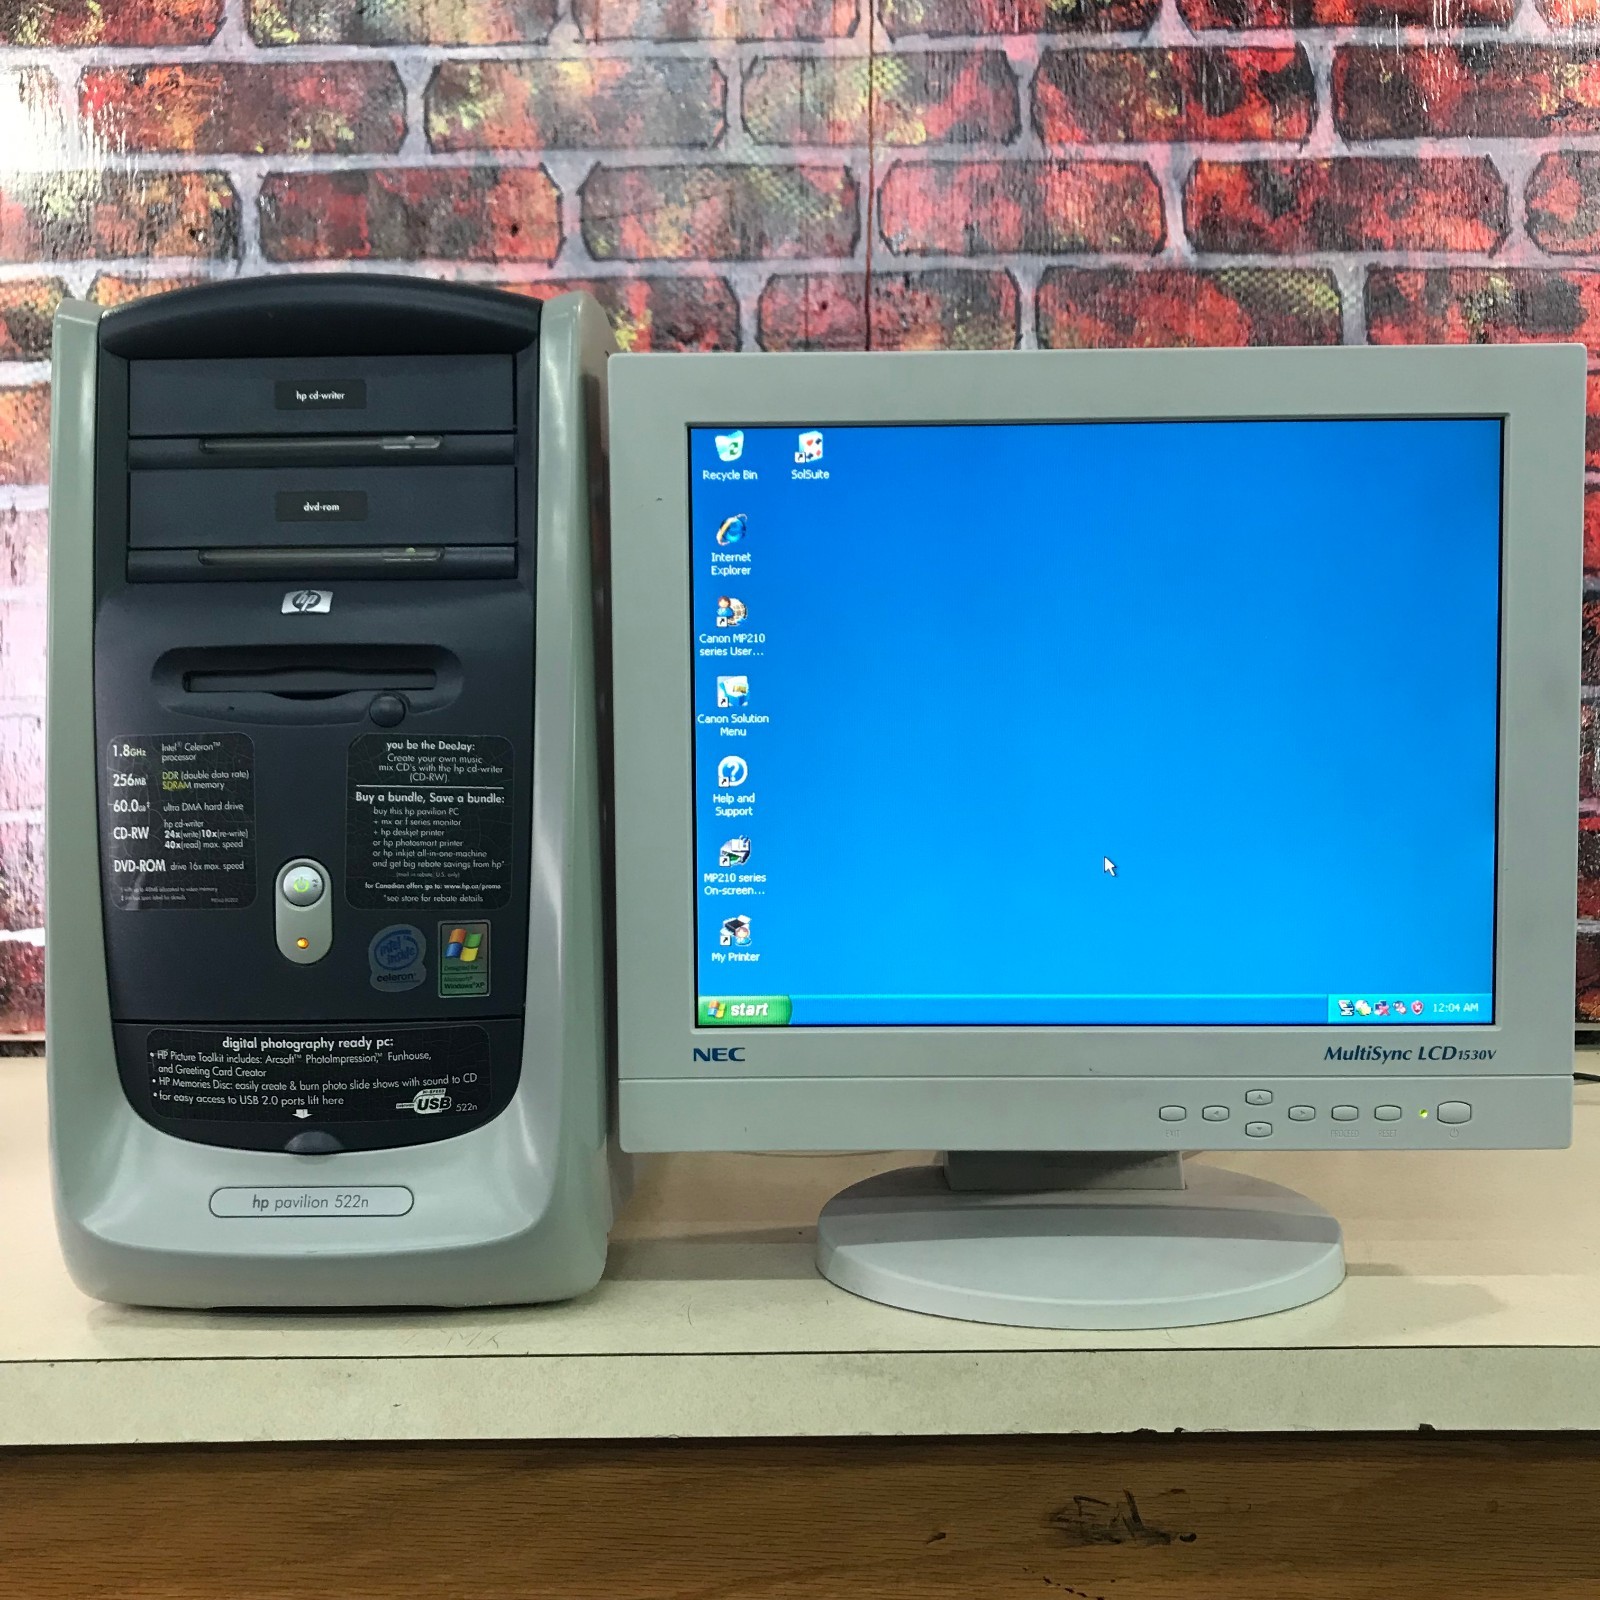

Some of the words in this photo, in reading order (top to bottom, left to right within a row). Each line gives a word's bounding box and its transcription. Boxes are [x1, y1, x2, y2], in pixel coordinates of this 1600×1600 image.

[296, 390, 307, 402] hp
[309, 390, 345, 400] cd-writer
[703, 470, 740, 481] Recycle
[743, 470, 758, 480] Bin
[791, 469, 830, 479] SolSuite
[303, 502, 340, 511] dvd-rom
[711, 552, 751, 562] Internet
[711, 565, 751, 576] Explorer
[296, 590, 318, 611] hp
[699, 634, 730, 644] Canon
[733, 633, 766, 643] MP210
[700, 647, 728, 656] series
[730, 646, 764, 656] User...
[697, 714, 729, 724] Canon
[731, 714, 770, 723] Solution
[720, 728, 746, 736] Menu
[113, 744, 147, 757] 1.8GHz
[387, 742, 404, 752] you
[406, 740, 419, 750] be
[421, 740, 436, 750] the
[438, 741, 475, 752] DeeJay:
[161, 753, 197, 763] processor
[387, 753, 415, 762] Create
[417, 755, 436, 764] your
[459, 756, 483, 764] music
[378, 763, 393, 771] mix
[396, 763, 417, 772] CD's
[418, 763, 436, 772] with
[439, 763, 452, 772] the
[453, 763, 465, 774] hp
[467, 764, 504, 773] cd-writer
[162, 771, 179, 780] DDR
[181, 770, 209, 781] (double
[211, 771, 229, 779] data
[231, 770, 249, 779] rate)
[162, 781, 192, 790] SDRAM
[193, 782, 225, 790] memory
[355, 791, 375, 804] Buy
[377, 794, 385, 802] a
[388, 791, 426, 804] bundle,
[429, 792, 455, 803] Save
[457, 795, 464, 803] a
[467, 793, 505, 804] bundle:
[713, 793, 734, 805] Help
[736, 792, 756, 803] and
[163, 803, 180, 812] ultra
[181, 803, 202, 811] DMA
[204, 802, 222, 811] hard
[224, 802, 244, 811] drive
[373, 806, 388, 816] buy
[389, 806, 402, 815] this
[404, 807, 415, 817] hp
[416, 807, 447, 817] pavilion
[449, 808, 460, 816] PC
[715, 806, 753, 817] Support
[163, 819, 173, 829] hp
[174, 820, 204, 828] cd-writer
[113, 826, 150, 840] CD-RW
[380, 828, 391, 838] hp
[393, 828, 419, 838] deskjet
[420, 829, 445, 838] printer
[222, 840, 243, 849] speed
[383, 839, 393, 849] hp
[395, 840, 437, 849] photosmart
[439, 840, 464, 849] printer
[383, 850, 393, 859] hp
[396, 850, 415, 859] inkjet
[114, 859, 166, 872] DVD-ROM
[170, 862, 187, 870] drive
[222, 861, 245, 871] speed
[389, 861, 401, 870] get
[403, 861, 416, 870] big
[443, 861, 471, 870] savings
[704, 873, 736, 882] MP210
[738, 873, 766, 882] series
[421, 894, 431, 902] for
[712, 952, 726, 963] My
[728, 952, 760, 962] Printer
[730, 1003, 769, 1016] start
[1433, 1003, 1461, 1013] 12:04
[1463, 1002, 1478, 1012] AM
[222, 1037, 258, 1051] digital
[261, 1037, 335, 1052] photography
[338, 1036, 372, 1050] ready
[376, 1038, 394, 1049] pc:
[157, 1050, 168, 1060] HP
[170, 1051, 196, 1062] Picture
[198, 1052, 225, 1063] Toolkit
[226, 1053, 263, 1064] includes:
[387, 1051, 432, 1061] Funhouse,
[694, 1047, 745, 1061] NEC
[1324, 1045, 1412, 1064] MultiSync
[158, 1065, 173, 1073] and
[175, 1065, 210, 1078] Greeting
[212, 1066, 233, 1076] Card
[235, 1067, 267, 1077] Creator
[159, 1077, 170, 1086] HP
[172, 1078, 211, 1089] Memories
[235, 1081, 259, 1092] easily
[261, 1081, 287, 1090] create
[300, 1081, 320, 1091] burn
[322, 1080, 347, 1092] photo
[349, 1079, 371, 1090] slide
[372, 1079, 400, 1089] shows
[401, 1077, 420, 1087] with
[423, 1075, 449, 1086] sound
[452, 1076, 461, 1084] to
[463, 1073, 478, 1083] CD
[159, 1090, 171, 1100] for
[174, 1094, 193, 1104] easy
[228, 1096, 237, 1104] to
[239, 1096, 259, 1105] USB
[262, 1096, 279, 1105] 2.0
[281, 1096, 305, 1107] ports
[308, 1096, 319, 1105] lift
[322, 1096, 344, 1105] here
[417, 1097, 451, 1110] USB
[455, 1103, 478, 1111] 522n
[252, 1194, 270, 1211] hp
[274, 1194, 329, 1211] pavilion
[334, 1194, 369, 1208] 522n
